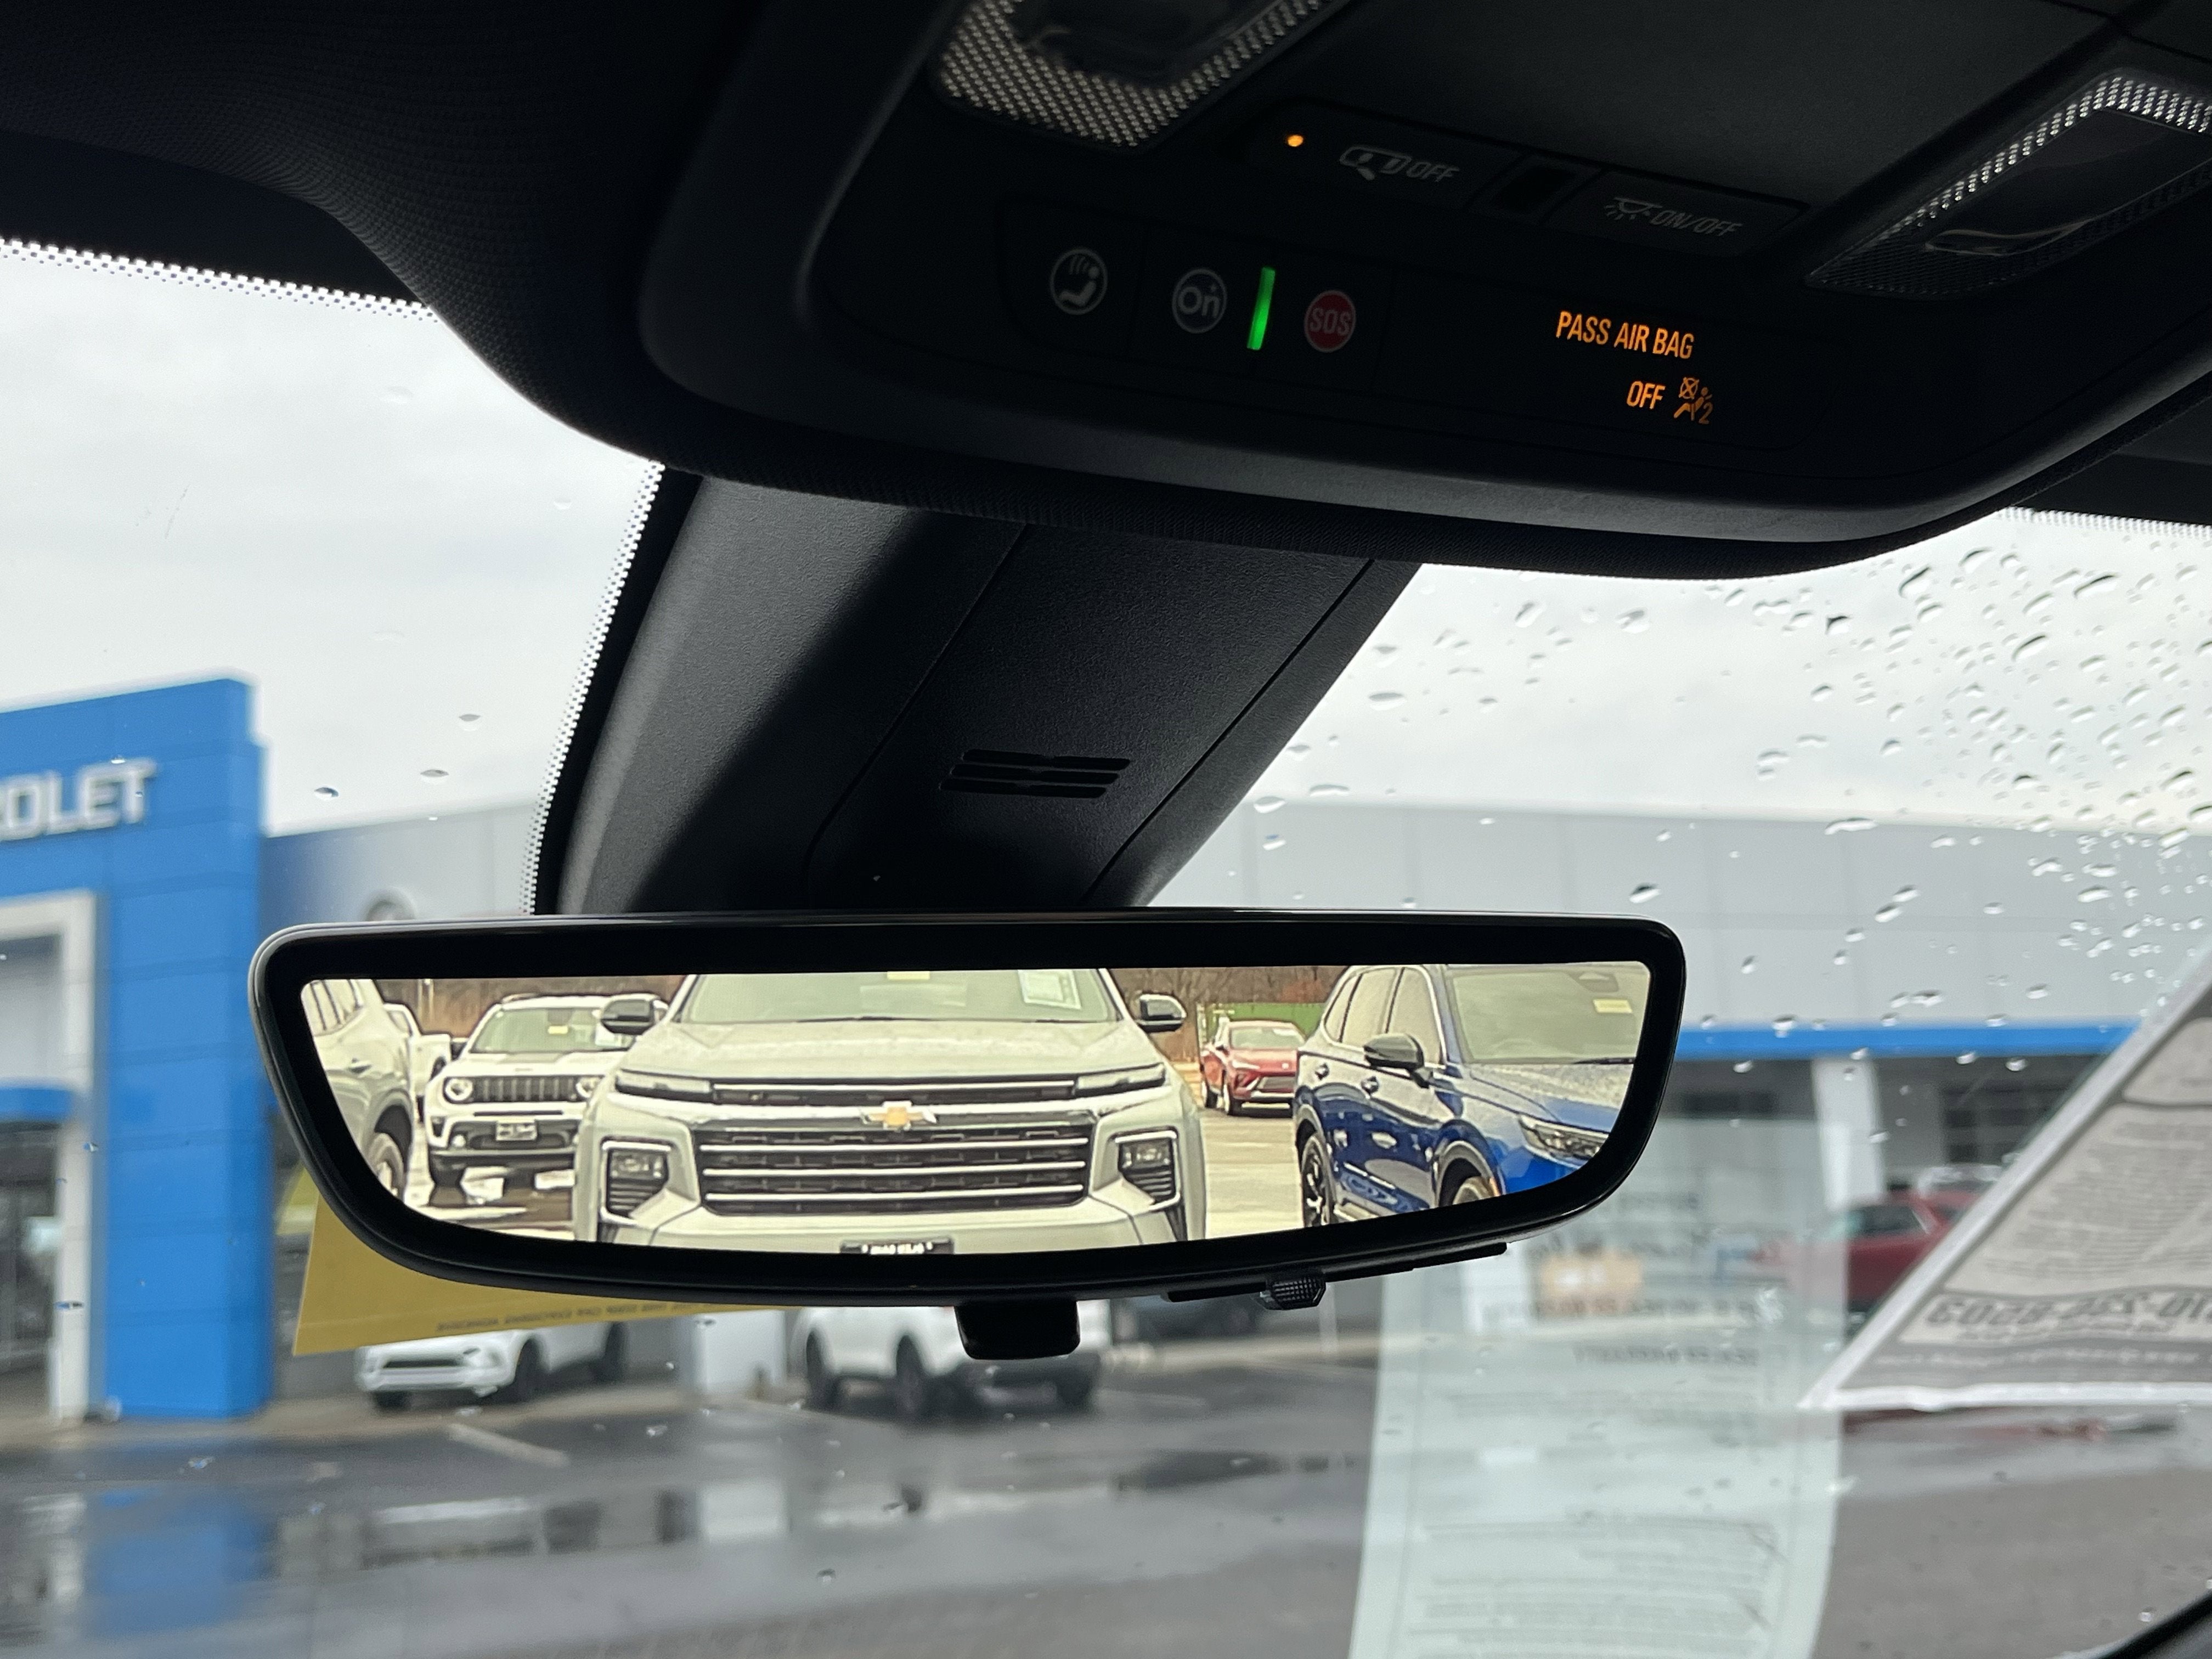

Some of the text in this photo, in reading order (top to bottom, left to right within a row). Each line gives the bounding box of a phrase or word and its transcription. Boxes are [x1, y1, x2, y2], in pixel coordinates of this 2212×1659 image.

[1406, 160, 1459, 183] OFF
[1650, 208, 1743, 237] ON/OFF
[1177, 285, 1221, 319] On
[1309, 307, 1352, 336] SOS
[1555, 310, 1695, 359] PASS AIR BAG
[1626, 380, 1666, 410] OFF
[0, 757, 156, 840] OLET
